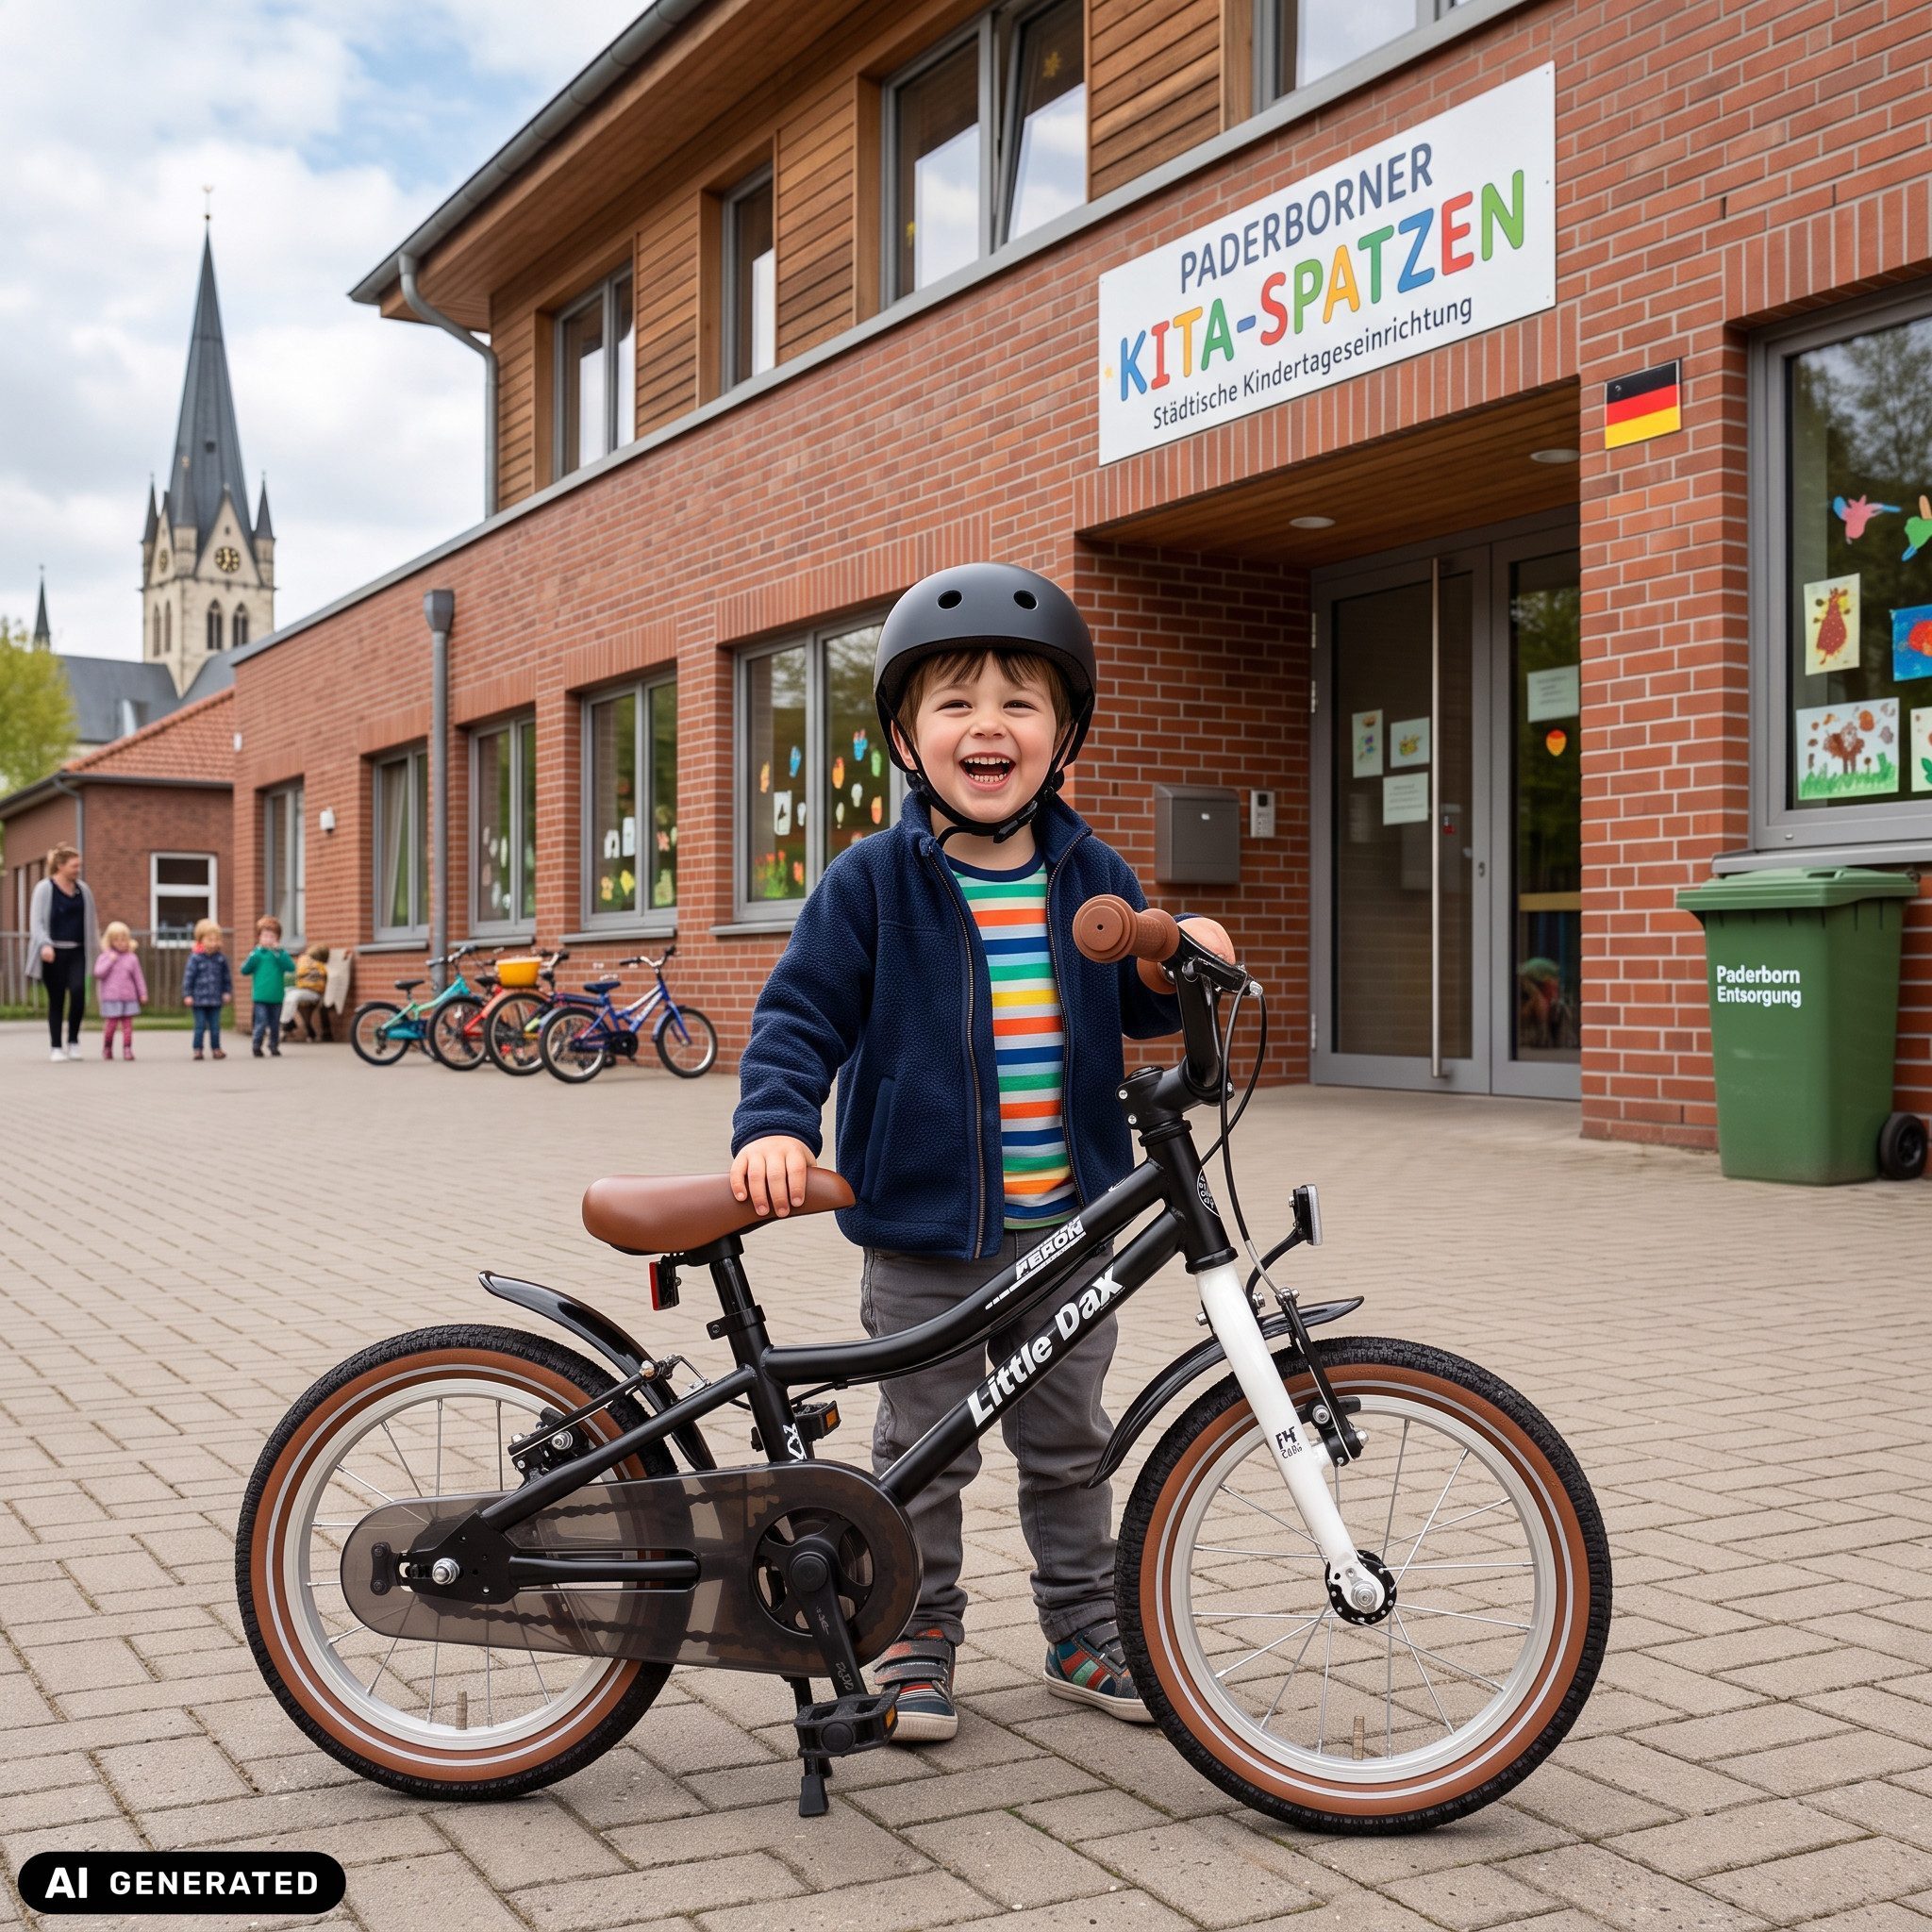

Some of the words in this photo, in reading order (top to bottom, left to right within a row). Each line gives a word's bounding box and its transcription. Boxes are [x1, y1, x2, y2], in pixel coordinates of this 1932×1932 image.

[1181, 142, 1434, 293] PADERBORNER
[1120, 170, 1524, 402] KITA-SPATZEN
[1153, 383, 1238, 430] Städtische
[1243, 297, 1473, 397] Kindertageseinrichtung
[1716, 964, 1801, 984] Paderborn
[1716, 986, 1802, 1008] Entsorgung
[966, 1335, 1053, 1428] Little
